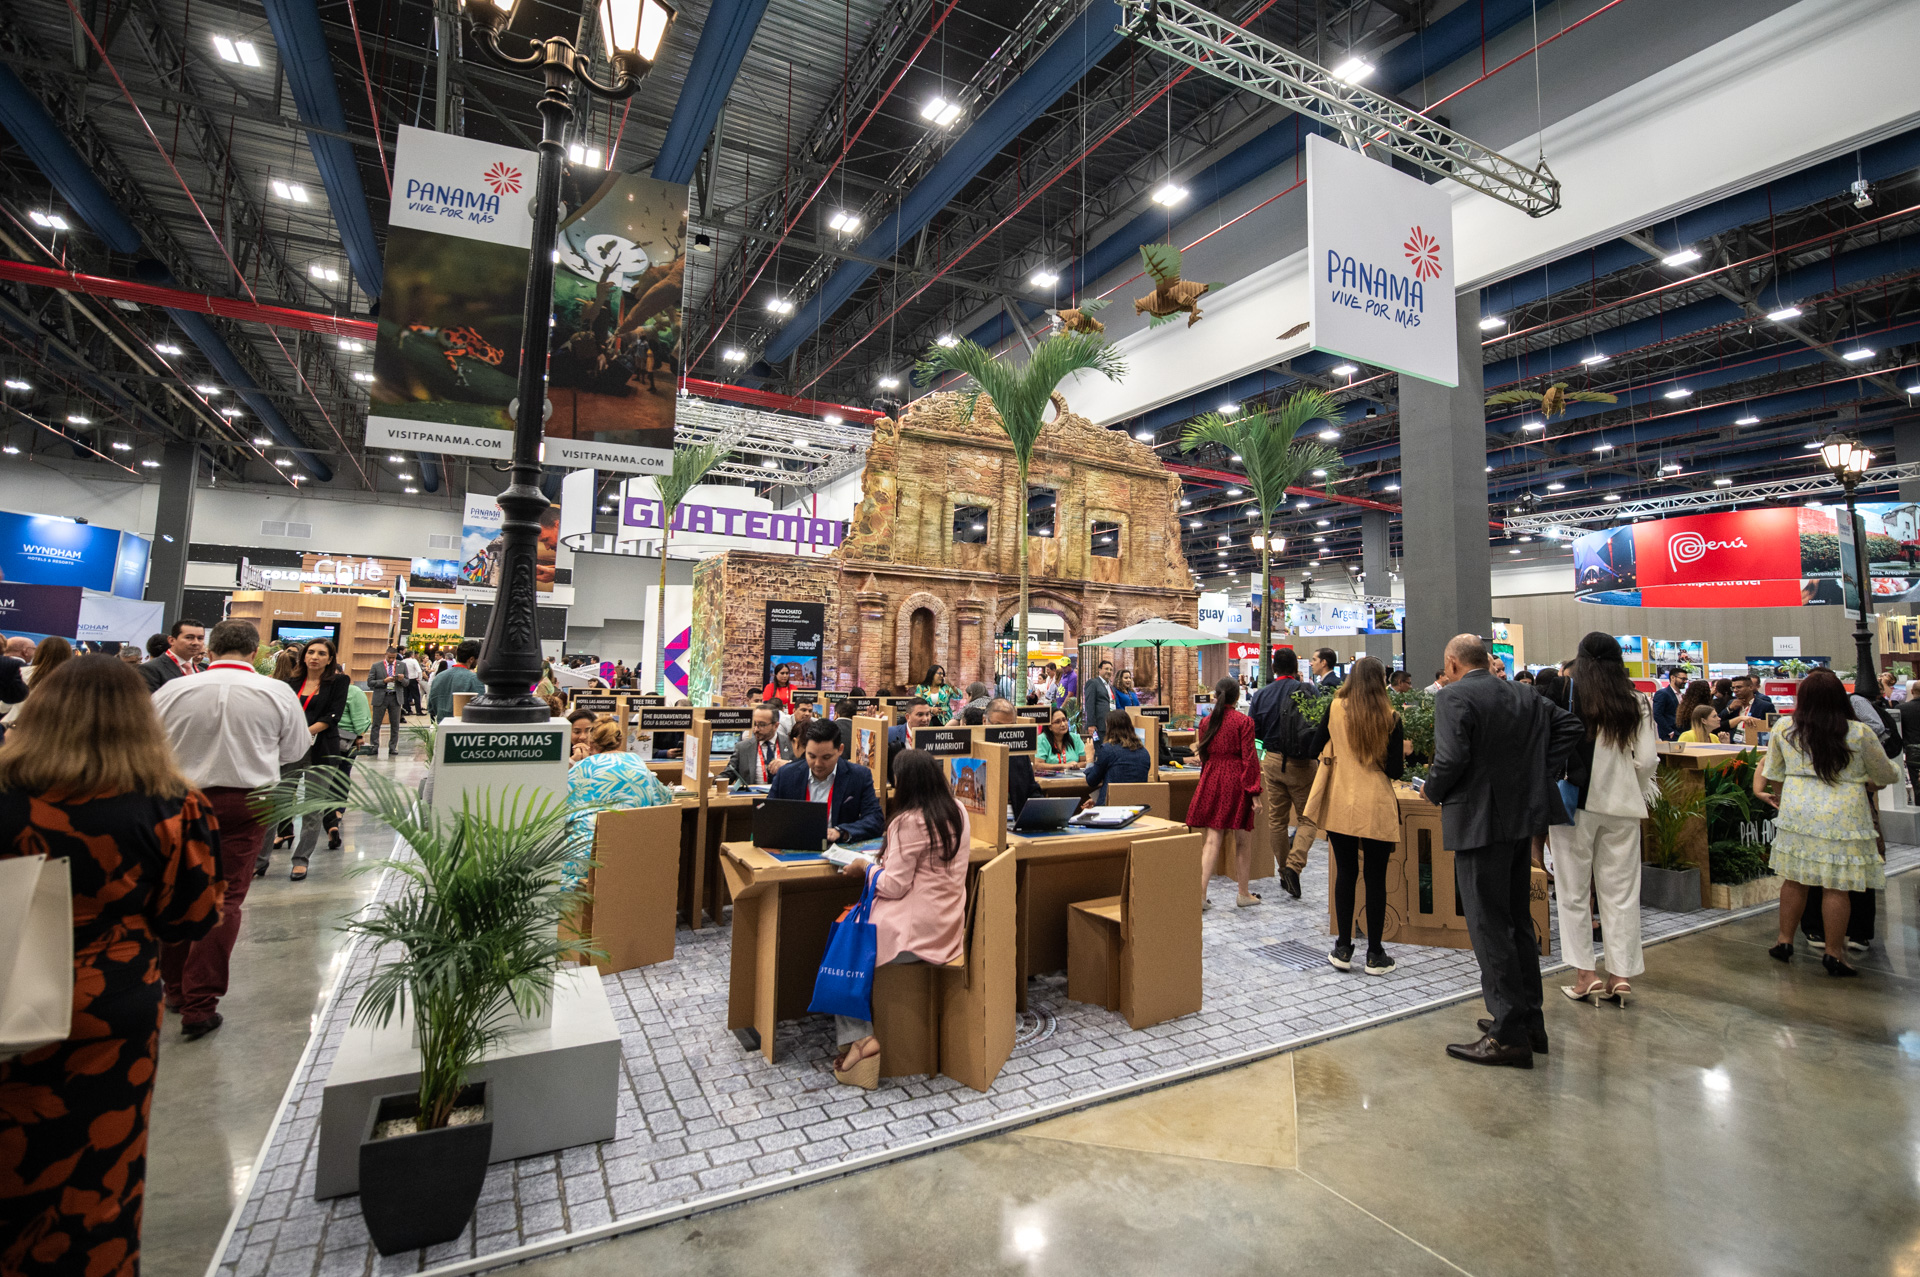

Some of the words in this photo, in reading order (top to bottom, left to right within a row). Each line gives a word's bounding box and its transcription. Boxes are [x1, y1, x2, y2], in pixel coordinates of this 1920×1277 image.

[406, 179, 500, 215] PANAMA
[408, 202, 437, 213] VIVE
[440, 207, 463, 219] POR
[468, 212, 494, 224] MÁS
[1327, 249, 1424, 313] PANAMA
[1332, 290, 1362, 309] VIVE
[1365, 300, 1390, 320] POR
[1395, 309, 1421, 328] MÁS
[388, 429, 502, 449] VISITPANAMA.COM
[562, 449, 665, 467] VISITPANAMA.COM
[470, 507, 501, 518] PANAMA
[23, 544, 82, 559] WYNDHAM
[1668, 531, 1748, 573] Perú
[261, 569, 336, 583] COLOMBIA
[314, 559, 384, 582] Chile
[1198, 608, 1225, 622] guay
[453, 735, 485, 747] VIVE
[489, 735, 518, 746] POR
[521, 734, 552, 746] MAS
[936, 732, 954, 740] HOTEL
[999, 730, 1025, 739] ACCENTO
[924, 743, 934, 751] JW
[935, 742, 964, 750] MARRIOTT
[460, 750, 496, 759] CASCO
[497, 749, 543, 758] ANTIGUO
[820, 966, 844, 977] TELES
